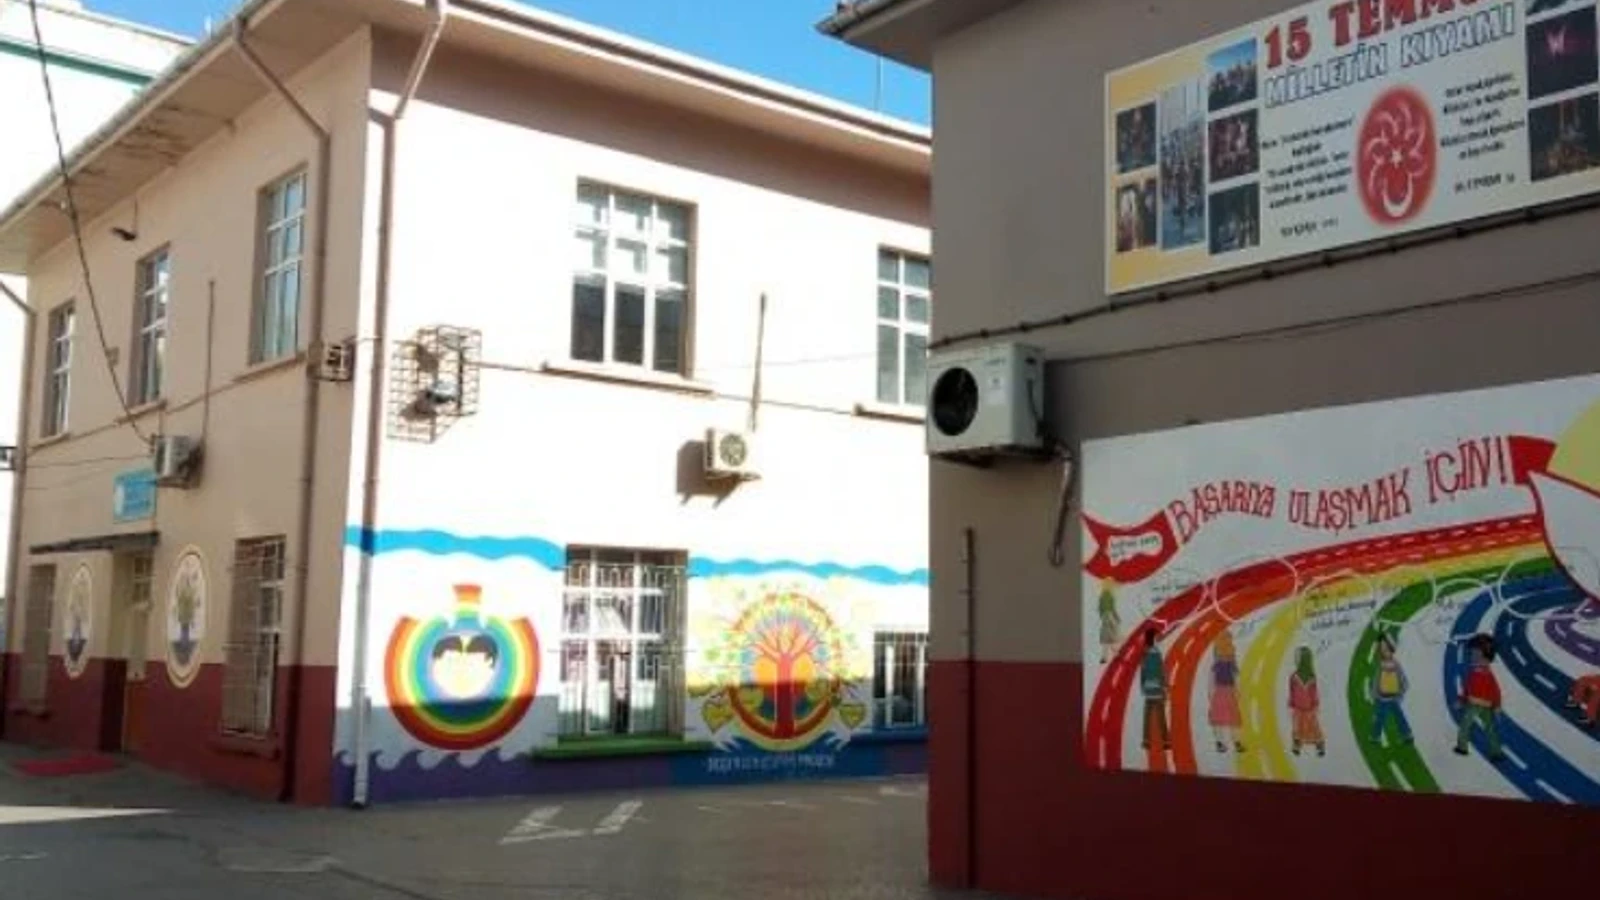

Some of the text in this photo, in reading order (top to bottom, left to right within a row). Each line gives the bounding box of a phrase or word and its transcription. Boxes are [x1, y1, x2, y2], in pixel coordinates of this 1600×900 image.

[1264, 15, 1312, 69] 15
[1264, 42, 1389, 108] MİLLETİN
[1400, 2, 1515, 68] KIYAMI
[1288, 467, 1411, 536] ULAŞMAK
[1424, 436, 1507, 503] İÇİN!
